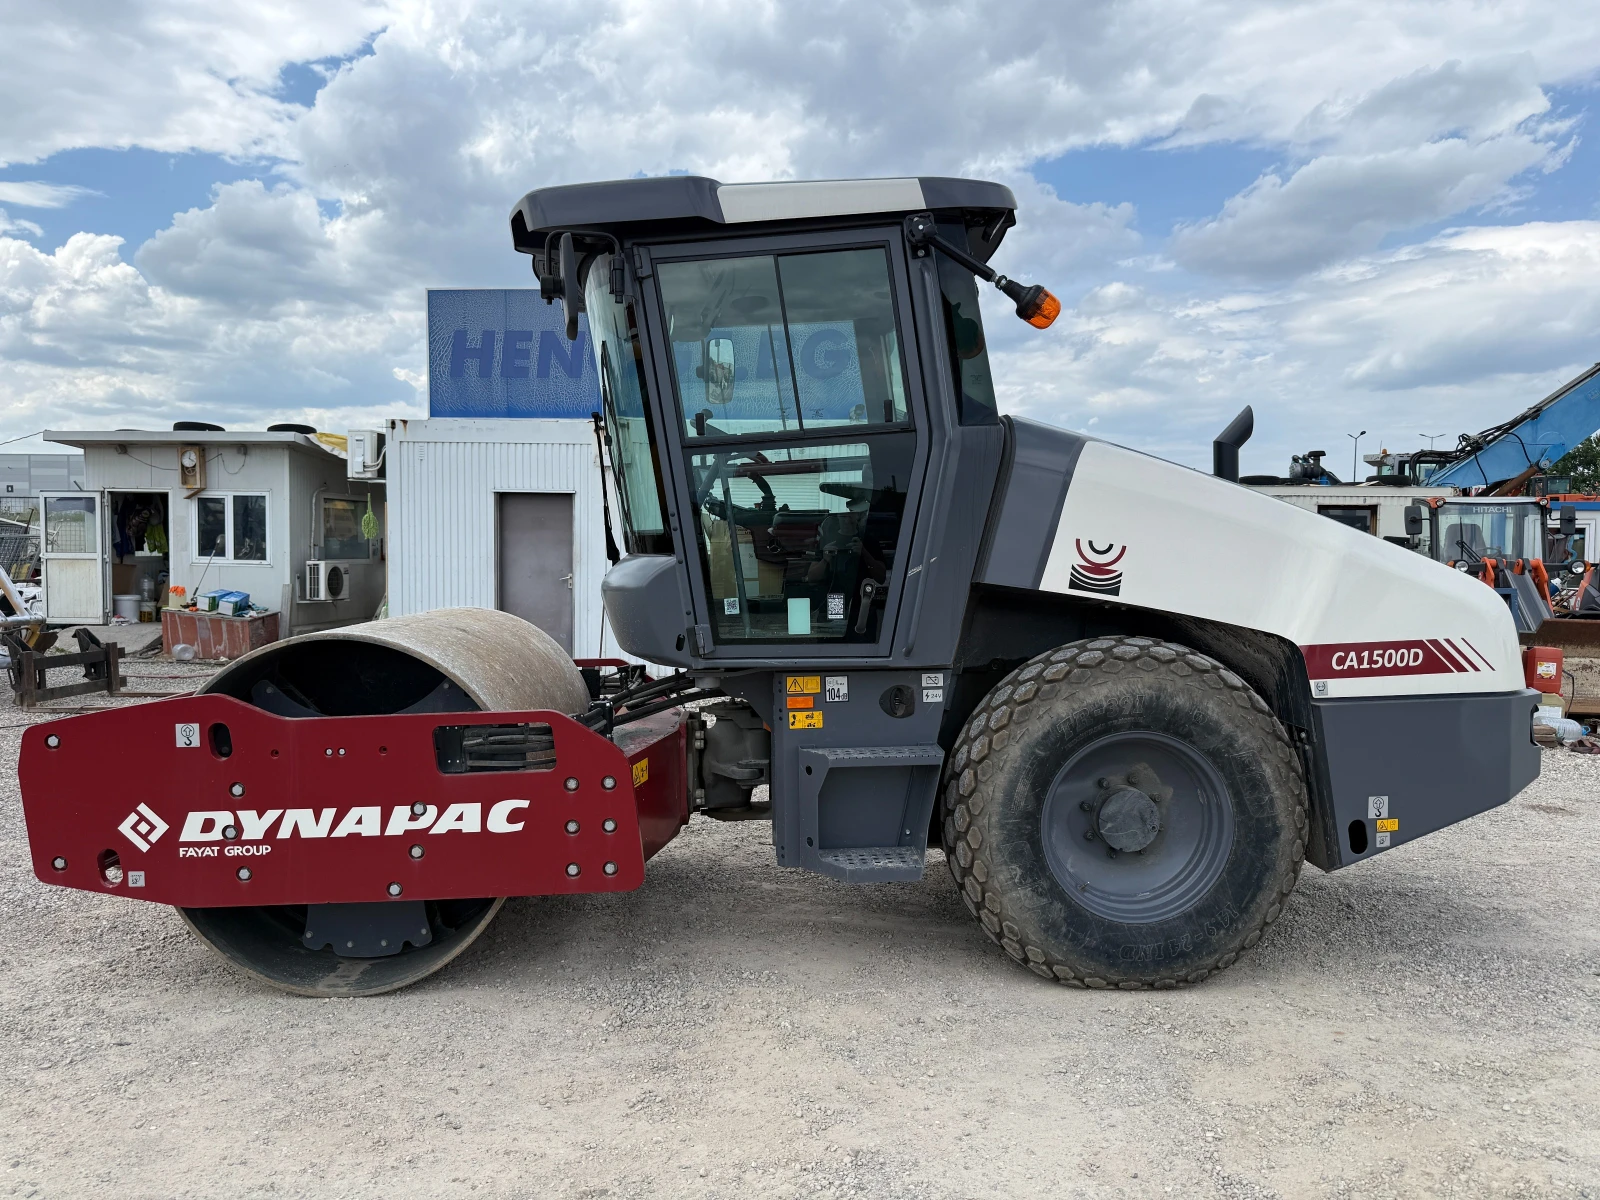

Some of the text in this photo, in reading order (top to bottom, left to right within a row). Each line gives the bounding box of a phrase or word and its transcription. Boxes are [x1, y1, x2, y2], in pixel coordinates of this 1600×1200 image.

[1472, 506, 1512, 514] HITACHI
[1331, 648, 1424, 670] CA1500D
[826, 687, 840, 701] 104
[178, 799, 531, 842] DYNAPAC
[179, 844, 272, 858] FAYAT GROUP
